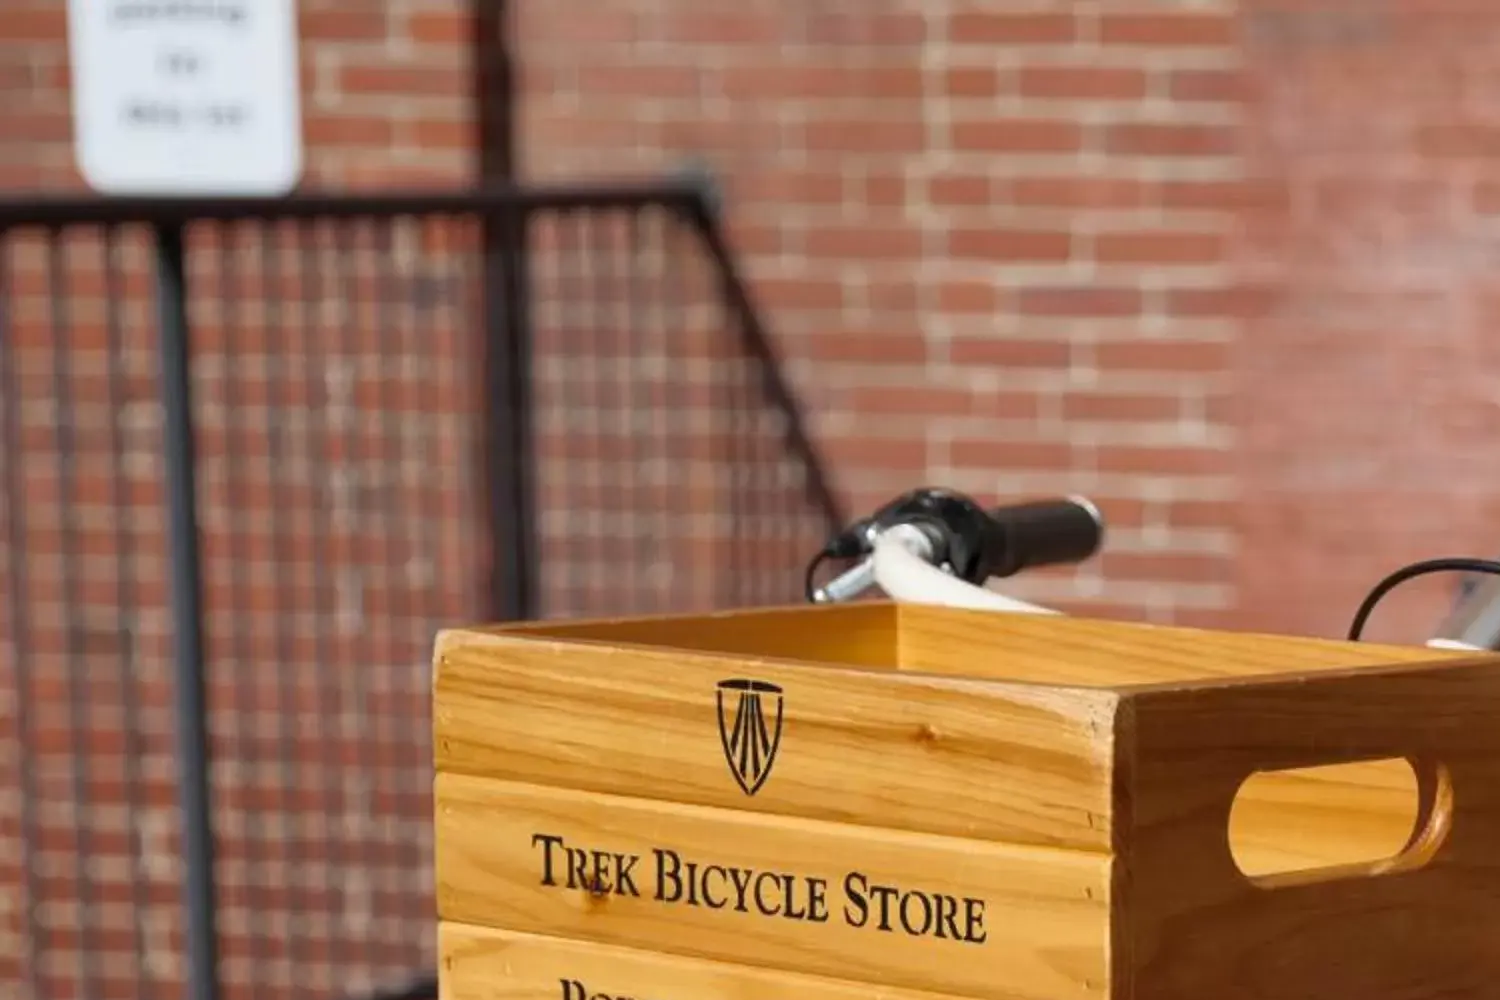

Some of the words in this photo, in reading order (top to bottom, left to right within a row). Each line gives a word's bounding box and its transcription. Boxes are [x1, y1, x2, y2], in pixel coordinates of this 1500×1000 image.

[531, 833, 641, 897] TREK
[652, 848, 829, 922] BICYCLE
[843, 871, 986, 943] STORE
